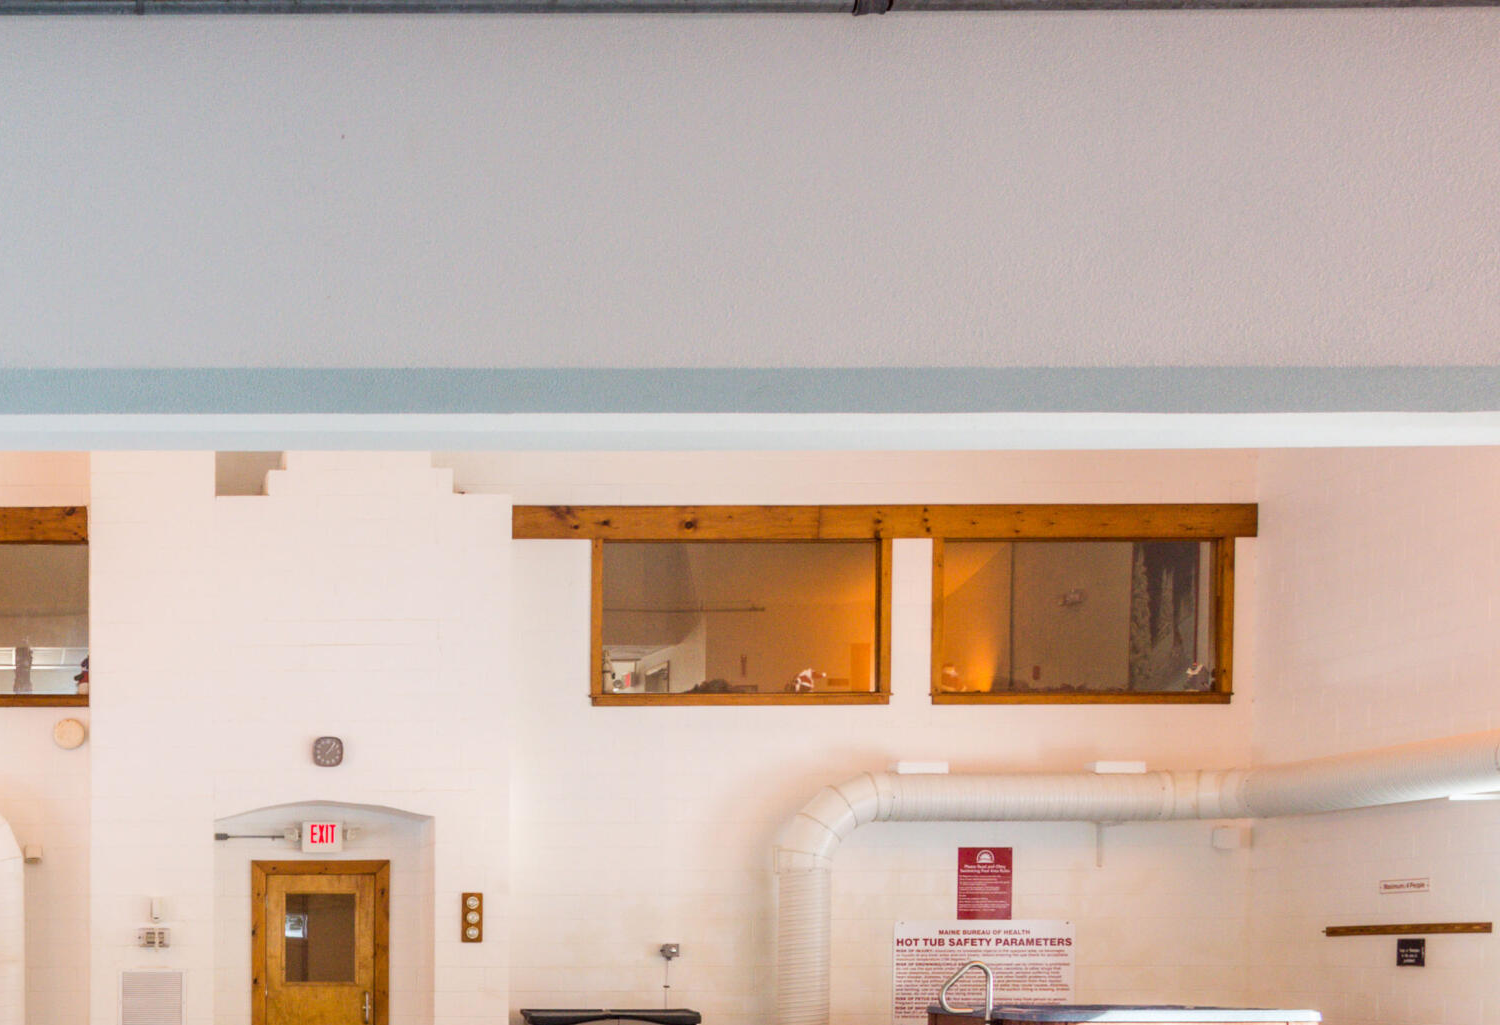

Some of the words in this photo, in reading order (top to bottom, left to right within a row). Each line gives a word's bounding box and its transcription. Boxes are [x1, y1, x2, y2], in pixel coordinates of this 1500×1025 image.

[310, 824, 336, 844] EXIT
[896, 938, 920, 947] HOT
[922, 938, 945, 947] TUB
[948, 938, 992, 947] SAFETY
[995, 938, 1073, 946] PARAMETERS
